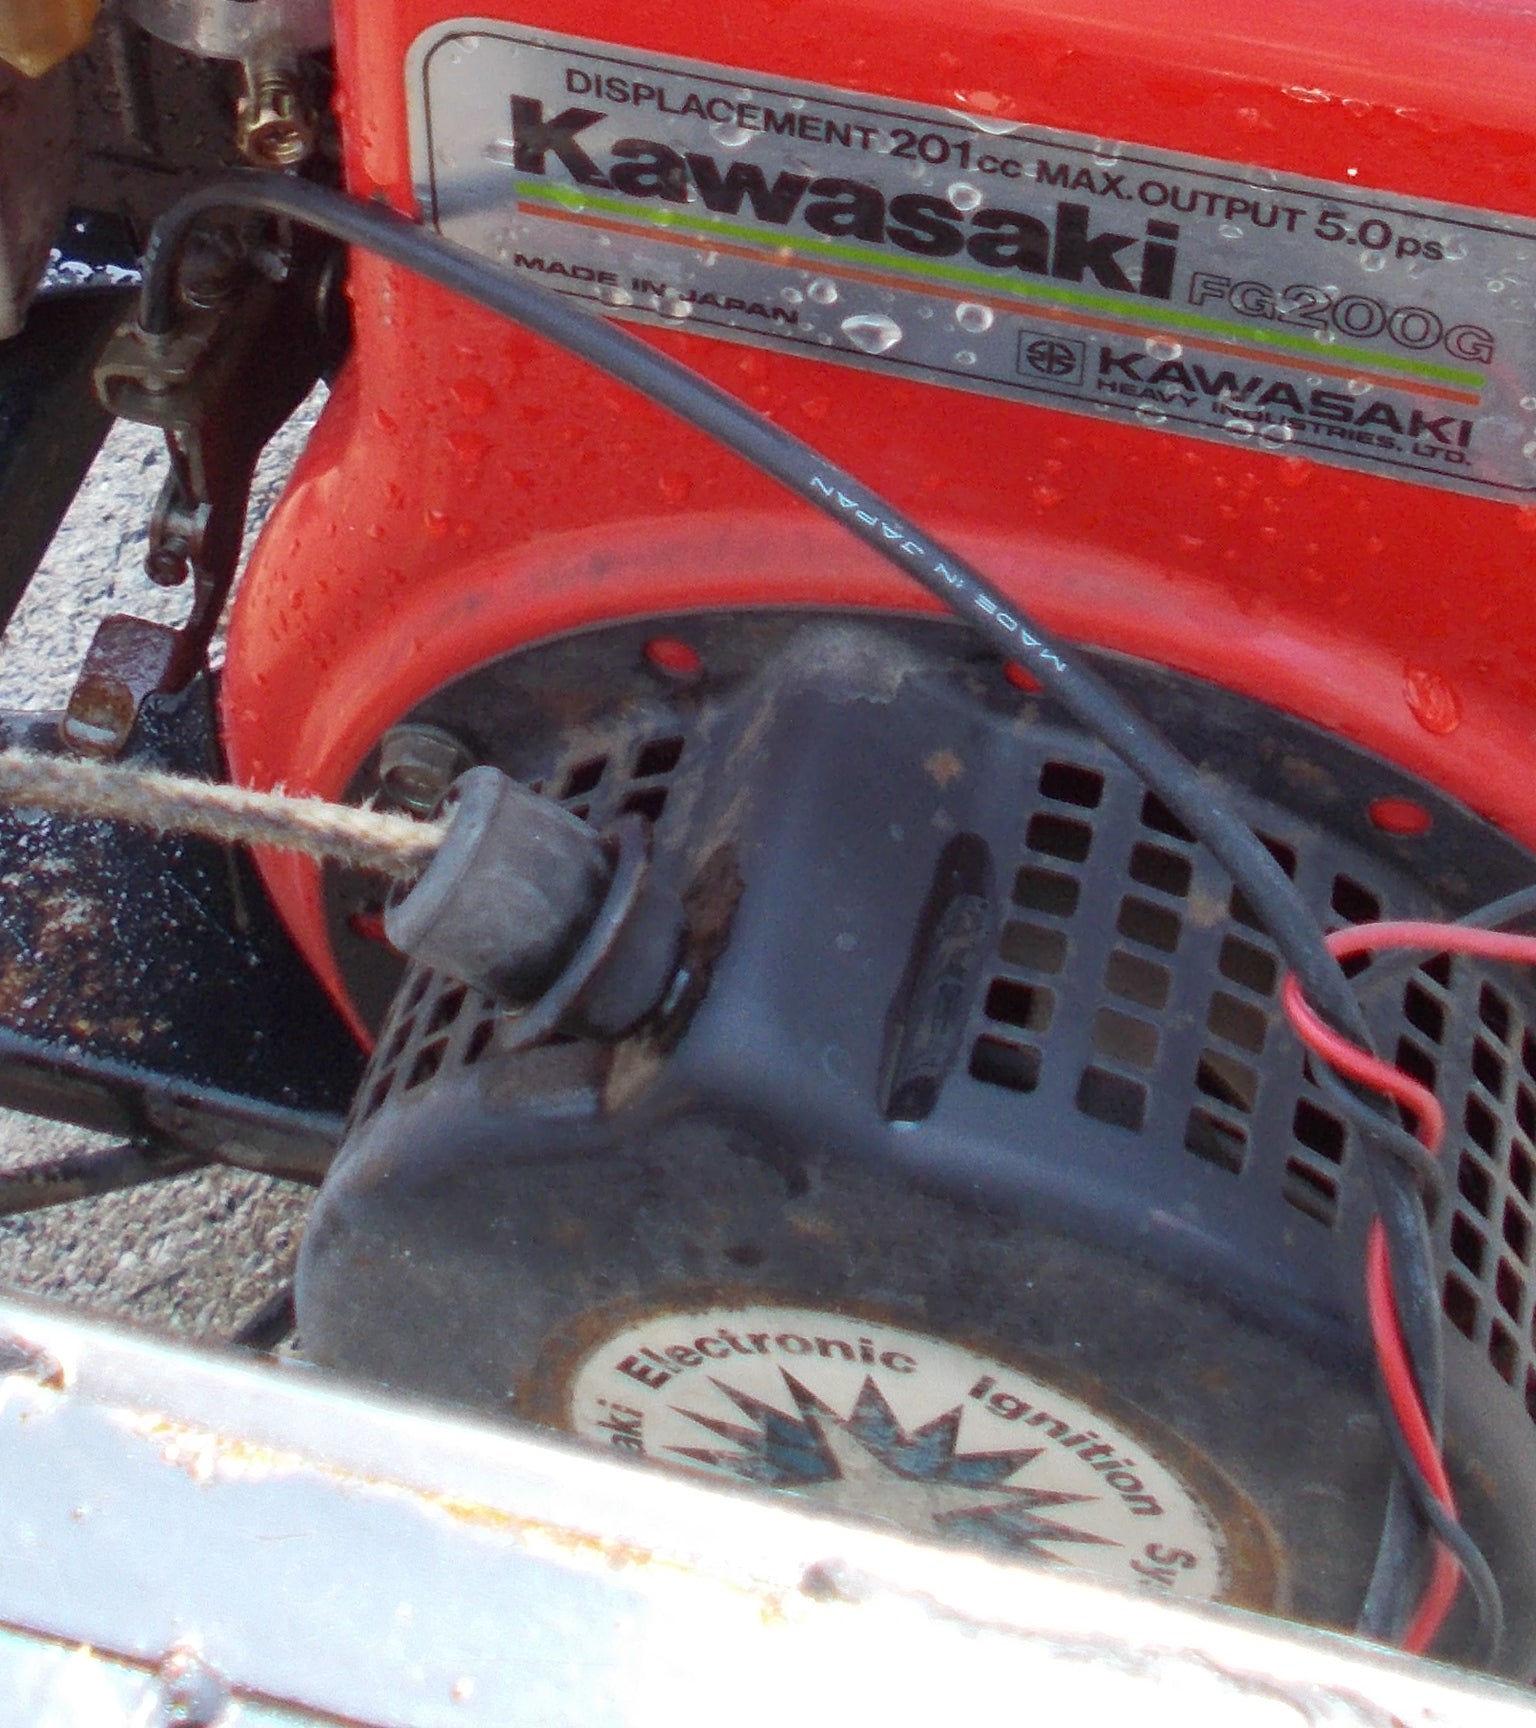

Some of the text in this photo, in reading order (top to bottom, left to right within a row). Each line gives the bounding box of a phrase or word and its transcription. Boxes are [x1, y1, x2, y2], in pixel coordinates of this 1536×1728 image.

[565, 69, 879, 150] DISPLACEMENT
[889, 128, 1022, 178] 201cc
[510, 94, 1496, 365] Kawasaki FG200G
[514, 253, 801, 325] MADE IN JAPAN
[1096, 377, 1200, 409] HEAVY
[1411, 441, 1474, 467] LTD.
[1097, 346, 1474, 450] KAWASAKI
[810, 476, 926, 555] JAPAN
[973, 593, 1067, 672] MADE
[596, 1328, 1198, 1588] aki Electronic Ignition Sy
